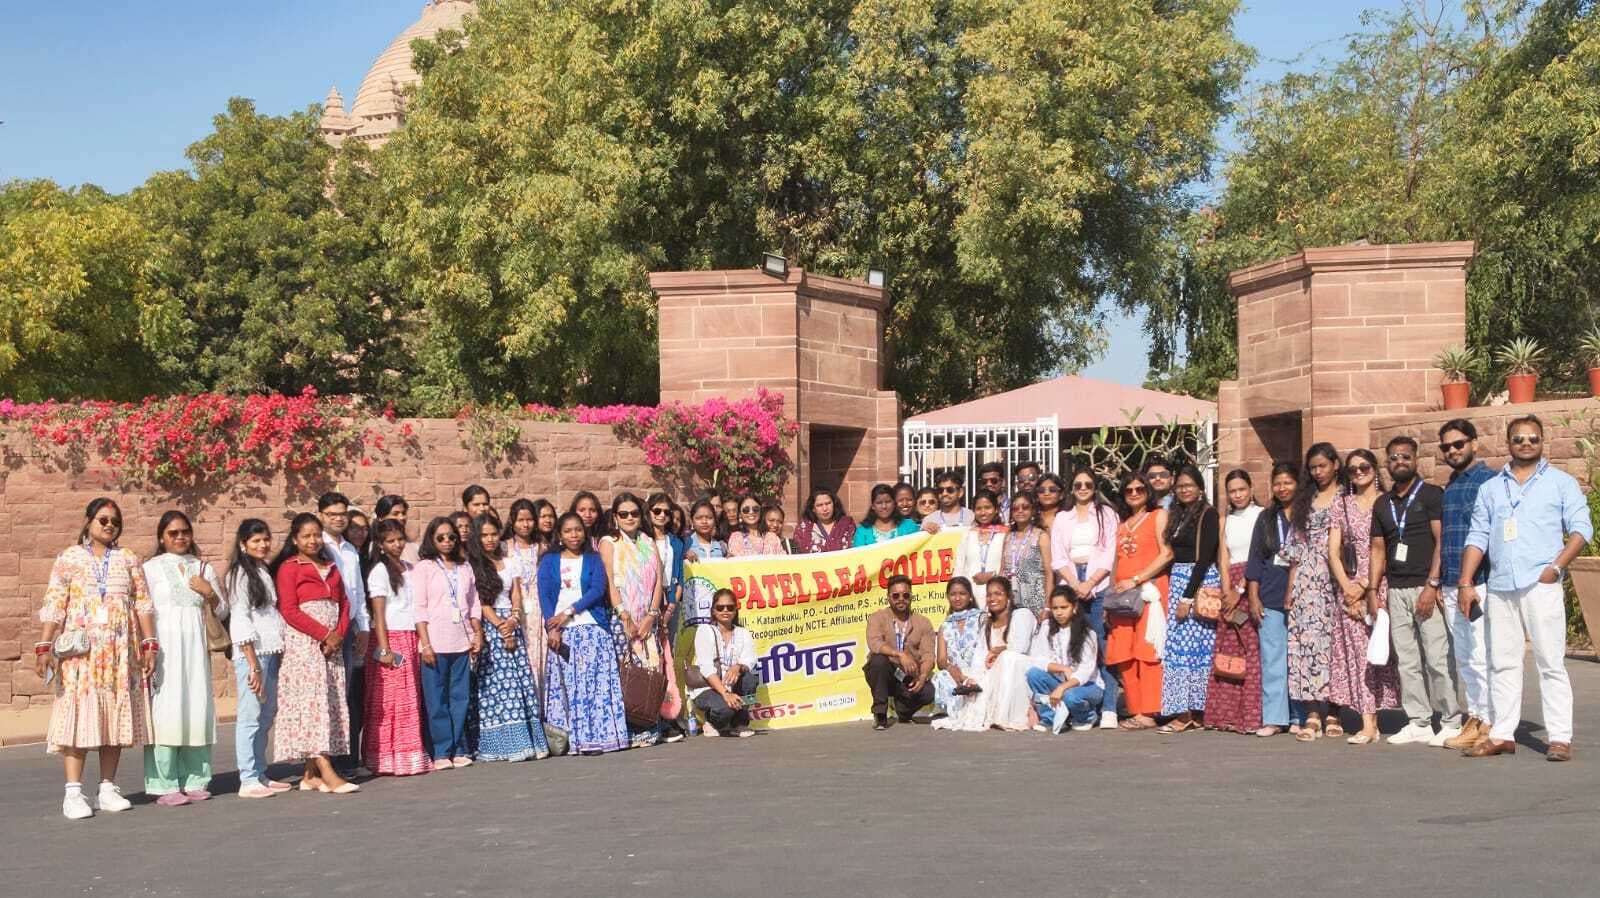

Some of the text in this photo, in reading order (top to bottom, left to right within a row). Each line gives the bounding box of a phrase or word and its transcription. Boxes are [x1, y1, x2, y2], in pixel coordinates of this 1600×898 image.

[730, 573, 811, 609] PATEL
[795, 624, 804, 635] by
[830, 613, 863, 626] Affiliated
[911, 604, 946, 614] niversity
